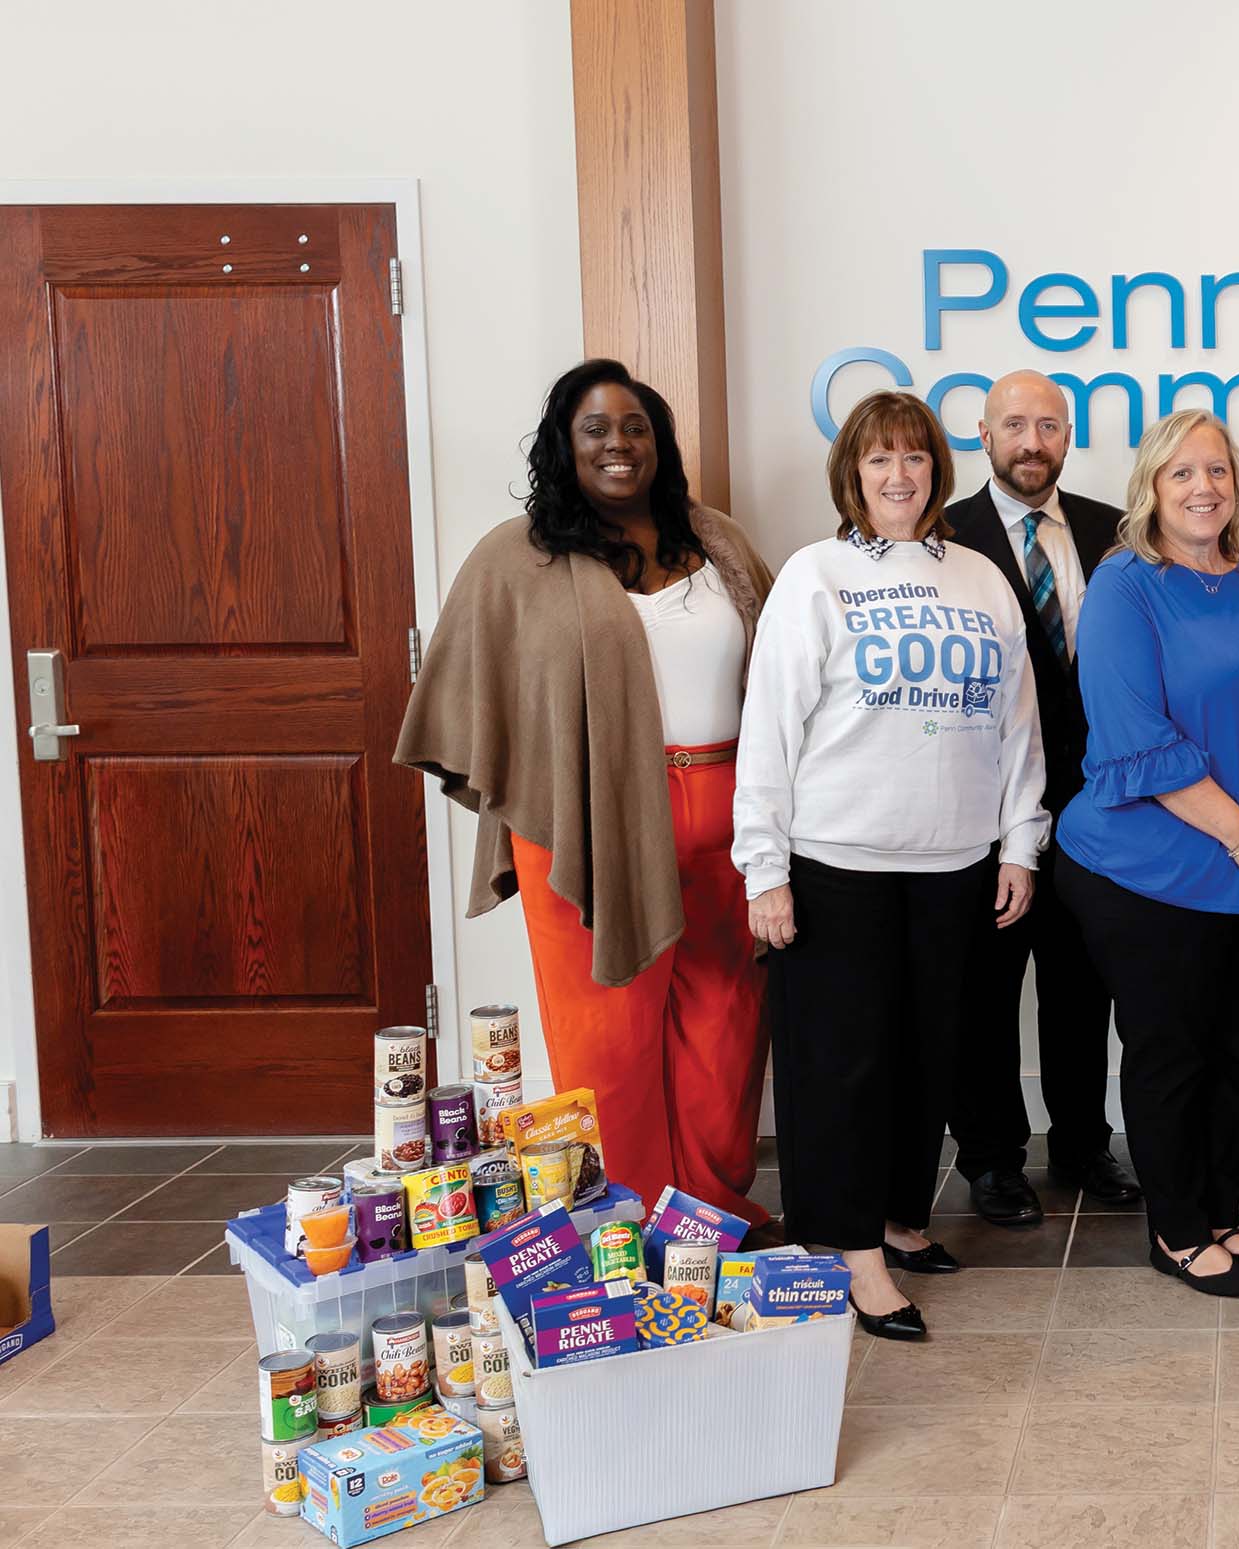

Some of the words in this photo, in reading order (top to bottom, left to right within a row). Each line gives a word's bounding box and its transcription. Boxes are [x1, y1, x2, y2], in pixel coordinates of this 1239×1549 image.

[839, 583, 939, 607] Operation
[845, 605, 997, 637] GREATER
[855, 633, 1002, 686] GOOD
[856, 687, 902, 705] Food
[909, 687, 959, 708] Drive
[489, 1025, 518, 1042] BEANS
[388, 1051, 421, 1066] BEANS
[438, 1107, 465, 1117] Black
[439, 1114, 468, 1125] Beans
[525, 1122, 553, 1140] Classic
[553, 1111, 580, 1130] Yellow
[431, 1169, 468, 1185] CENTO
[422, 1228, 457, 1241] CRUSHED
[680, 1216, 722, 1243] PENNE
[509, 1235, 555, 1266] PENNE
[511, 1245, 562, 1276] RIGATE
[679, 1256, 708, 1266] sliced
[667, 1265, 711, 1282] CARROTS
[724, 1278, 739, 1290] 24
[793, 1279, 824, 1289] triscuit
[768, 1287, 799, 1303] thin
[800, 1289, 844, 1304] crisps
[560, 1319, 611, 1339] PENNE
[559, 1331, 615, 1350] RIGATE
[381, 1348, 401, 1360] Chili
[450, 1350, 472, 1364] CO
[318, 1367, 358, 1388] CORN
[275, 1465, 298, 1481] CO
[350, 1478, 363, 1490] 12
